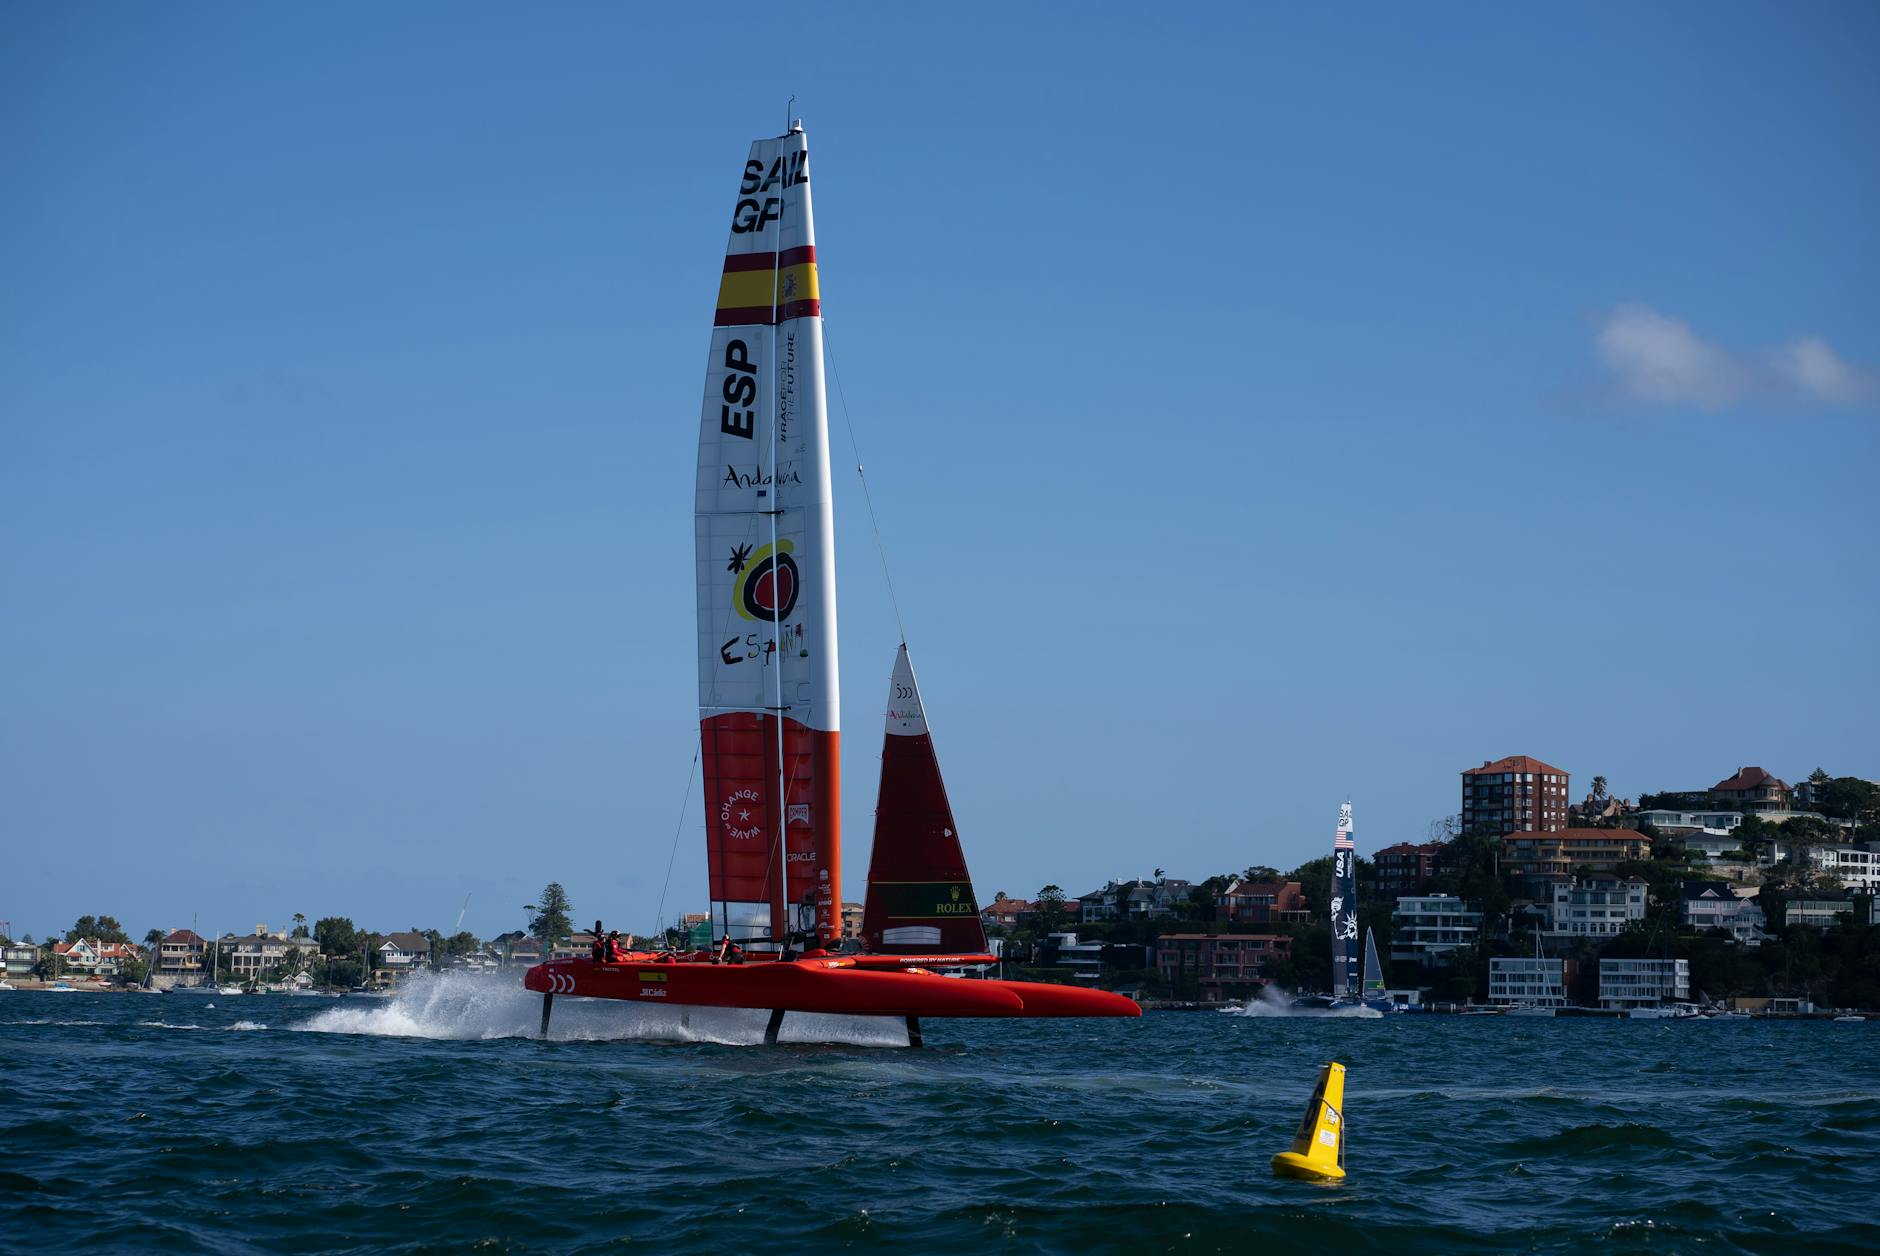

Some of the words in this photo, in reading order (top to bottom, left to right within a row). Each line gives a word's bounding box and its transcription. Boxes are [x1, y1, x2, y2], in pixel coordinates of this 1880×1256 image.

[739, 149, 809, 194] SAIL
[732, 197, 783, 234] GP
[721, 338, 757, 440] ESP
[730, 826, 761, 840] WAVE
[787, 852, 817, 863] ORACLE
[1335, 851, 1345, 878] USA
[936, 902, 973, 914] ROLEX
